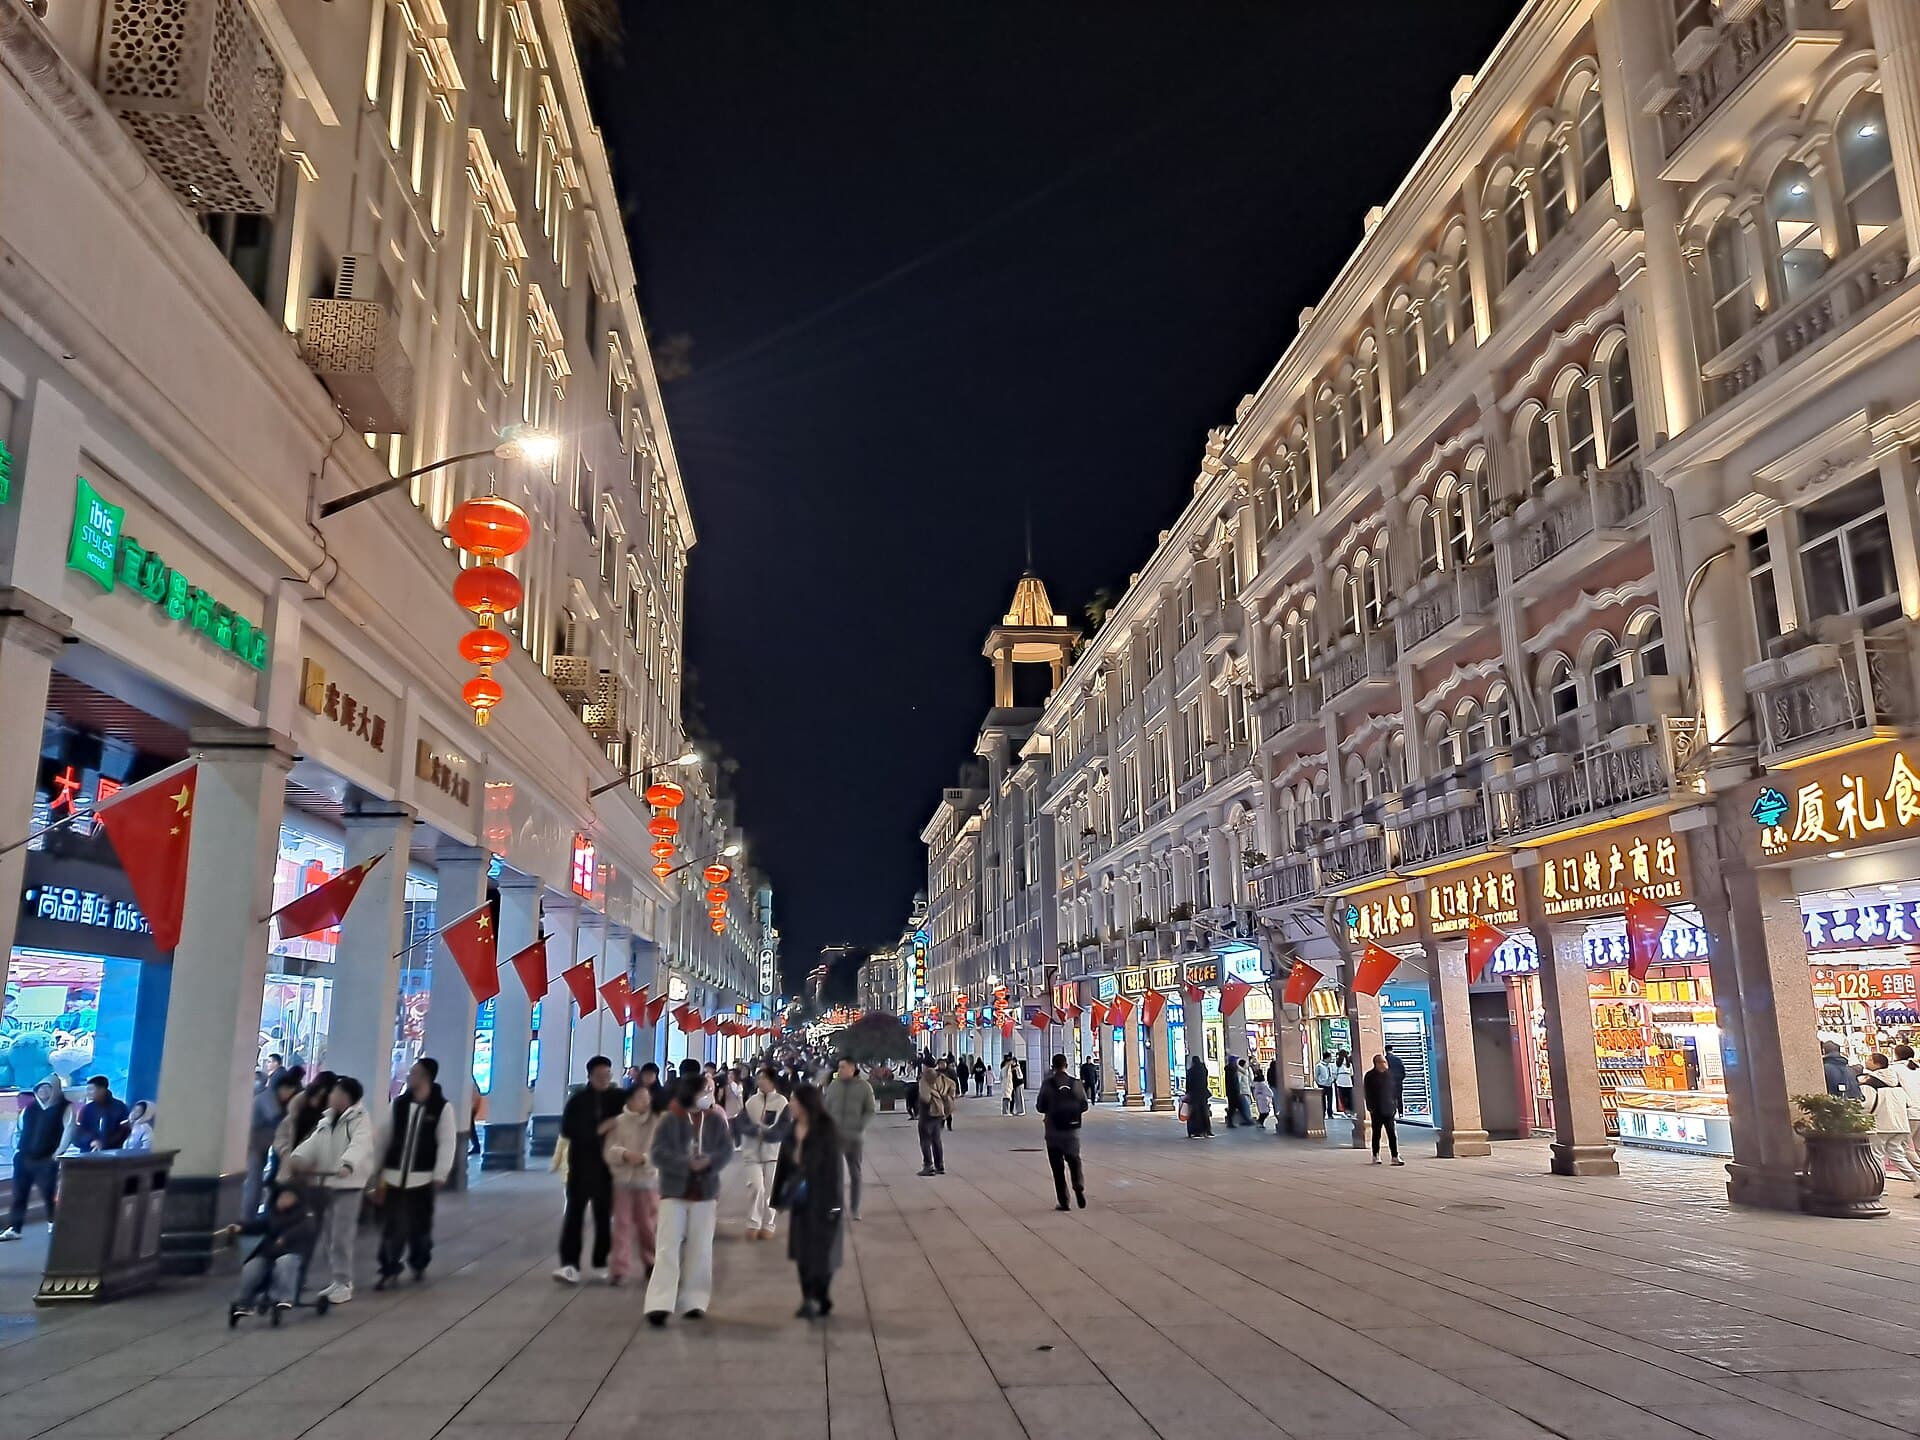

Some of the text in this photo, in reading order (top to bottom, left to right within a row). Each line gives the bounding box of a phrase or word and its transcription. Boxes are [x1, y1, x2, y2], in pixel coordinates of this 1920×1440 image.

[89, 499, 113, 536] ibis
[86, 551, 106, 570] HOTELS
[1543, 837, 1676, 900] 厦门特产商行
[38, 885, 110, 927] 尚品酒店
[114, 901, 138, 931] ibis
[1360, 895, 1414, 939] 厦礼食品
[1544, 896, 1583, 915] XIAMEN
[1642, 881, 1681, 900] STORE
